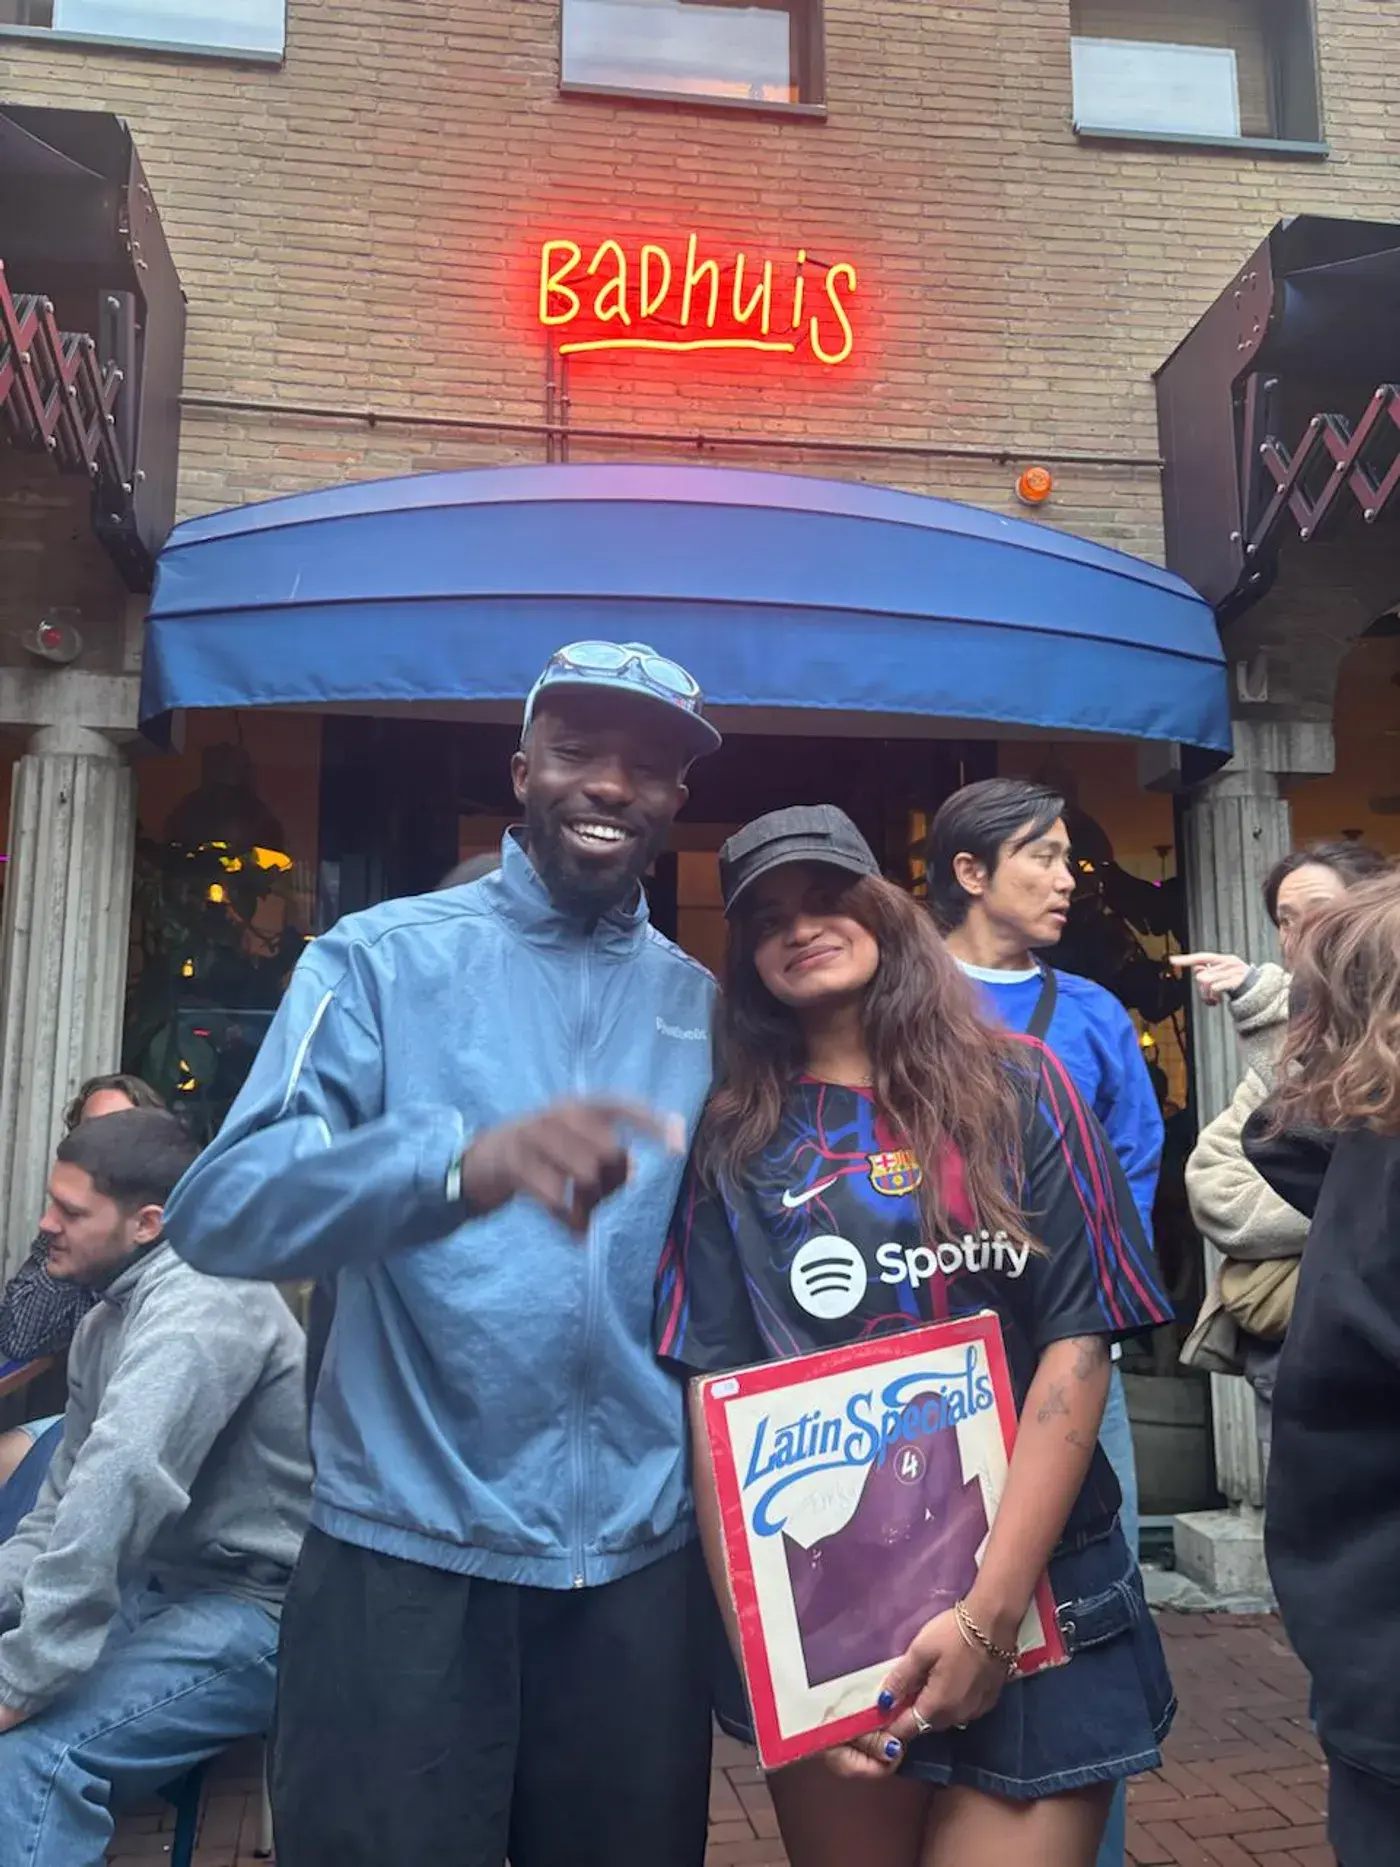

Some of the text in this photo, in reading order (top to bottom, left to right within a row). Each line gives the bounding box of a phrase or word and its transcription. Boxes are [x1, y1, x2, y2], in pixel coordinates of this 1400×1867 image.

[876, 1229, 1030, 1288] Spotify
[743, 1345, 994, 1490] Latin Specials
[901, 1451, 919, 1479] 4
